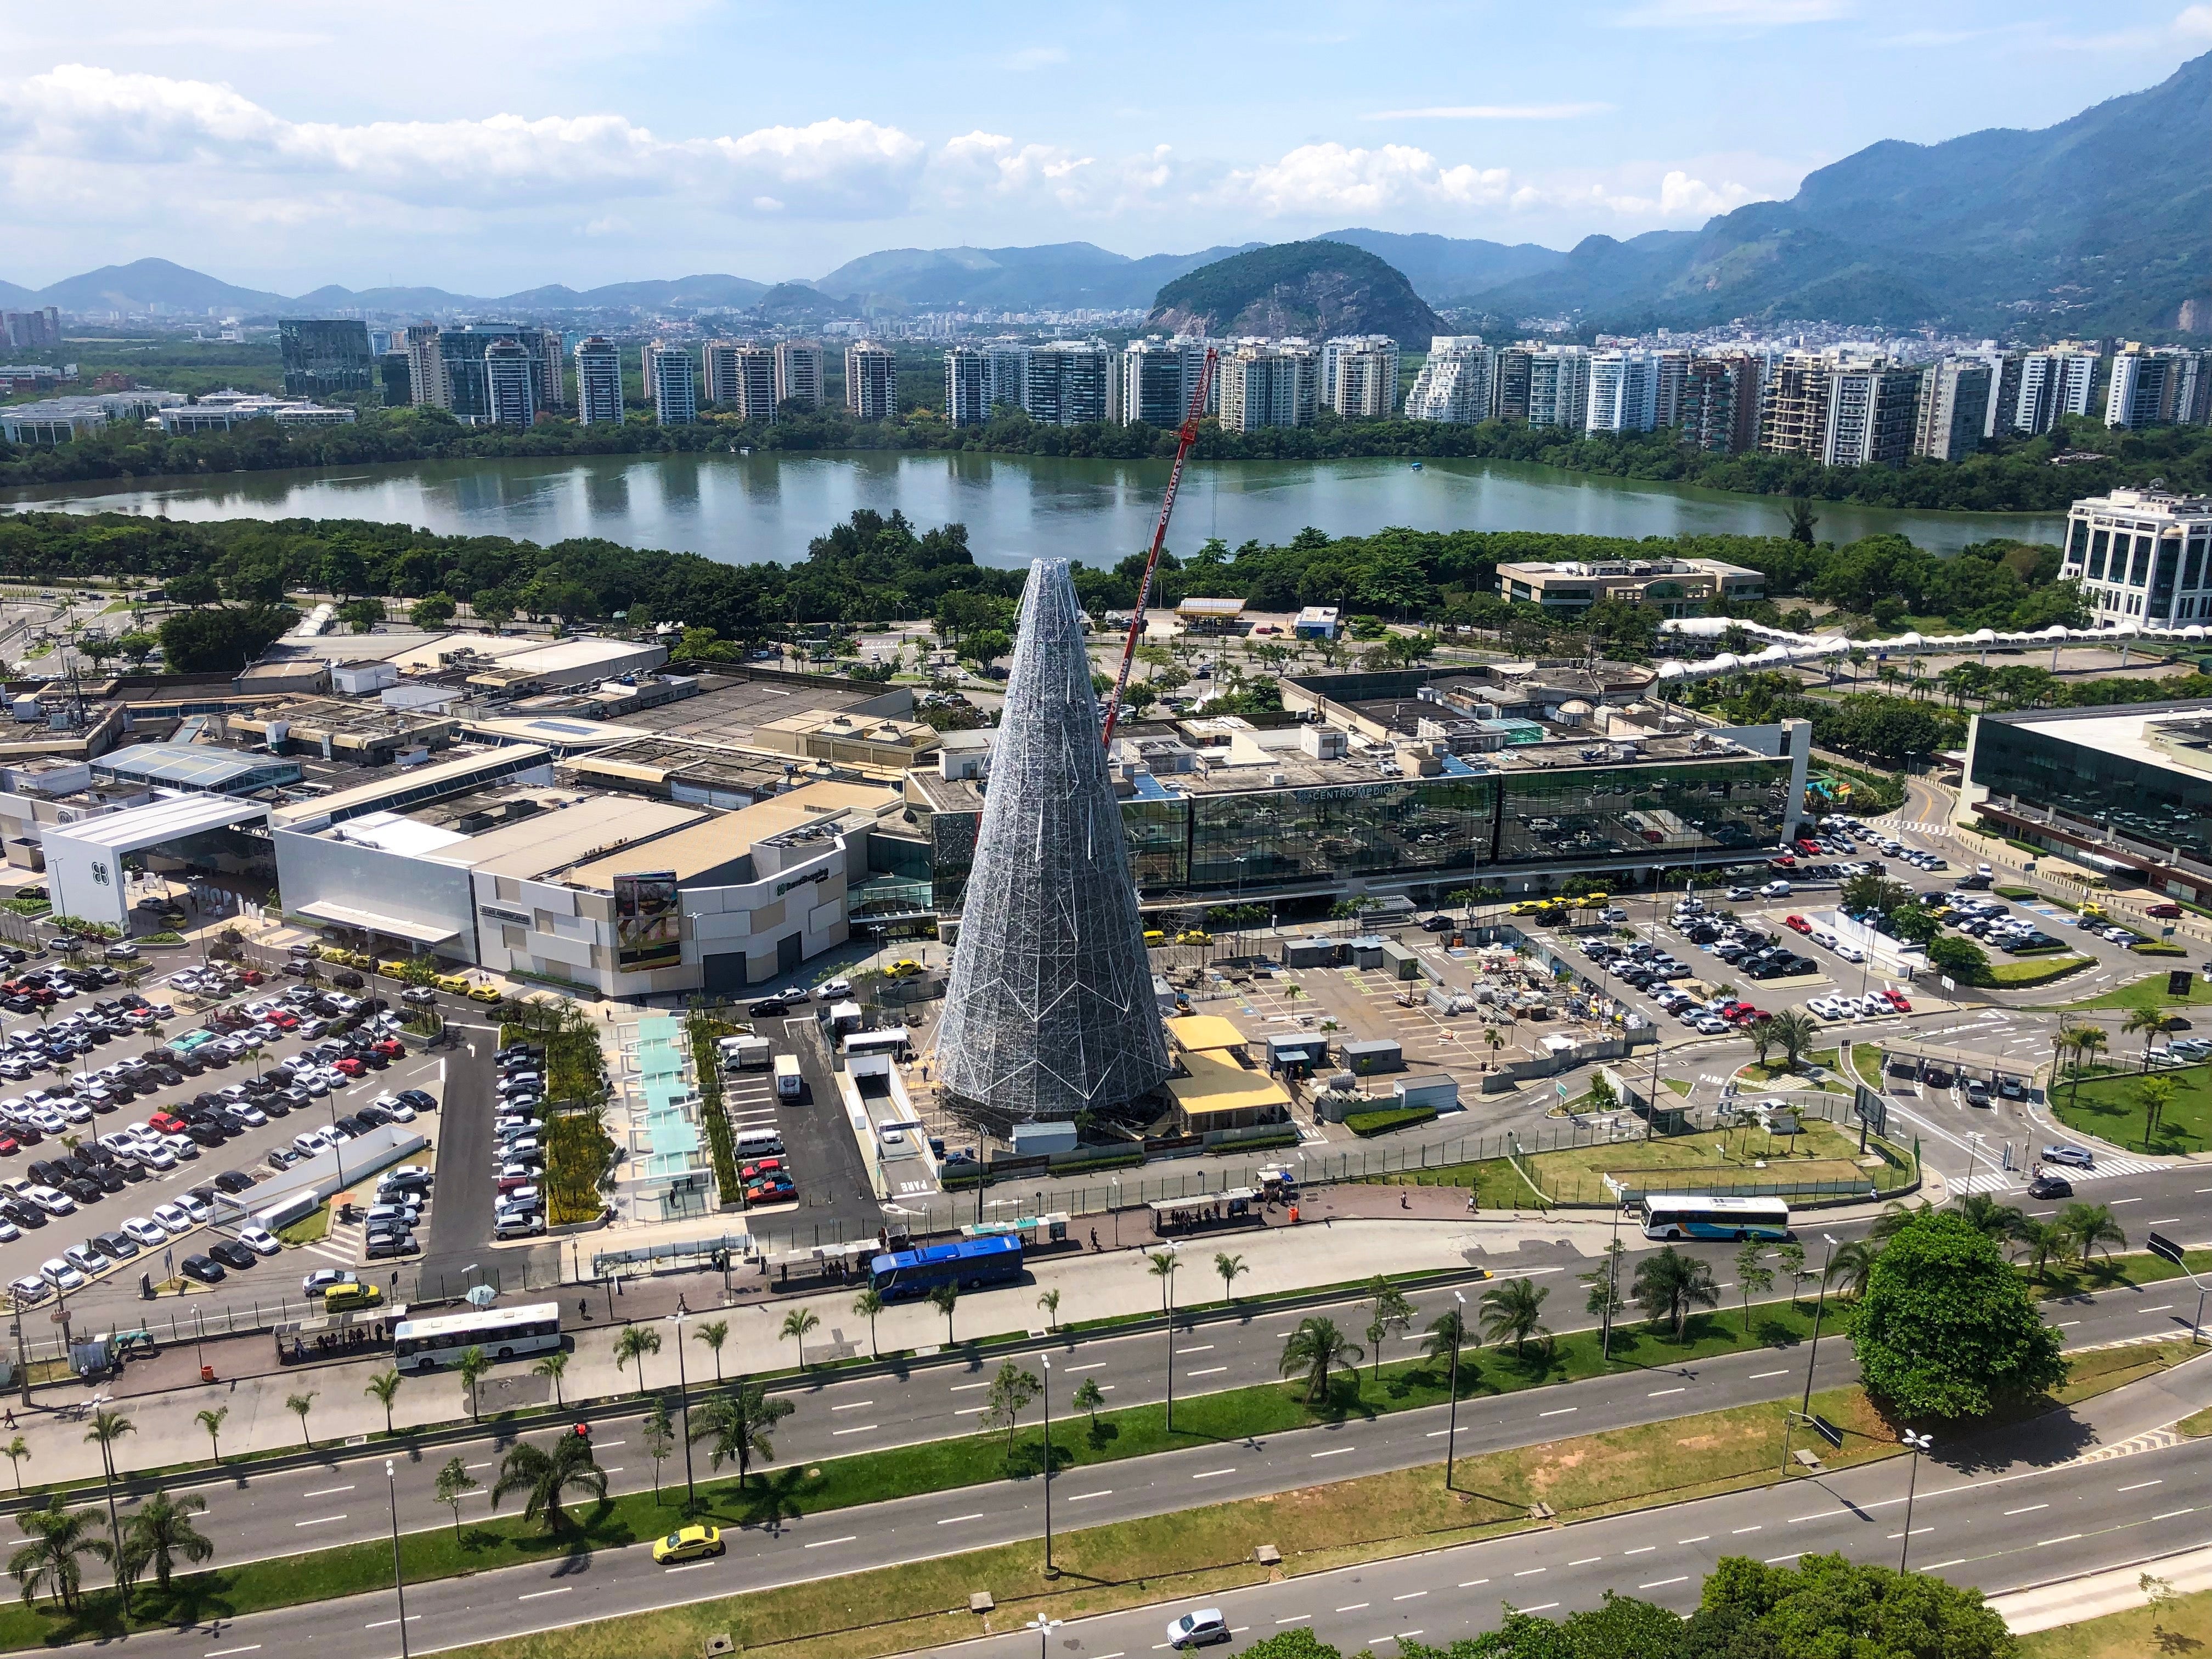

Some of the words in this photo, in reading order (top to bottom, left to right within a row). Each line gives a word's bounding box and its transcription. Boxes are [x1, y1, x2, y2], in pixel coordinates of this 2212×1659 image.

[1313, 789, 1354, 800] CENTRO
[1699, 1074, 1724, 1085] PARE
[900, 1180, 927, 1192] PARE
